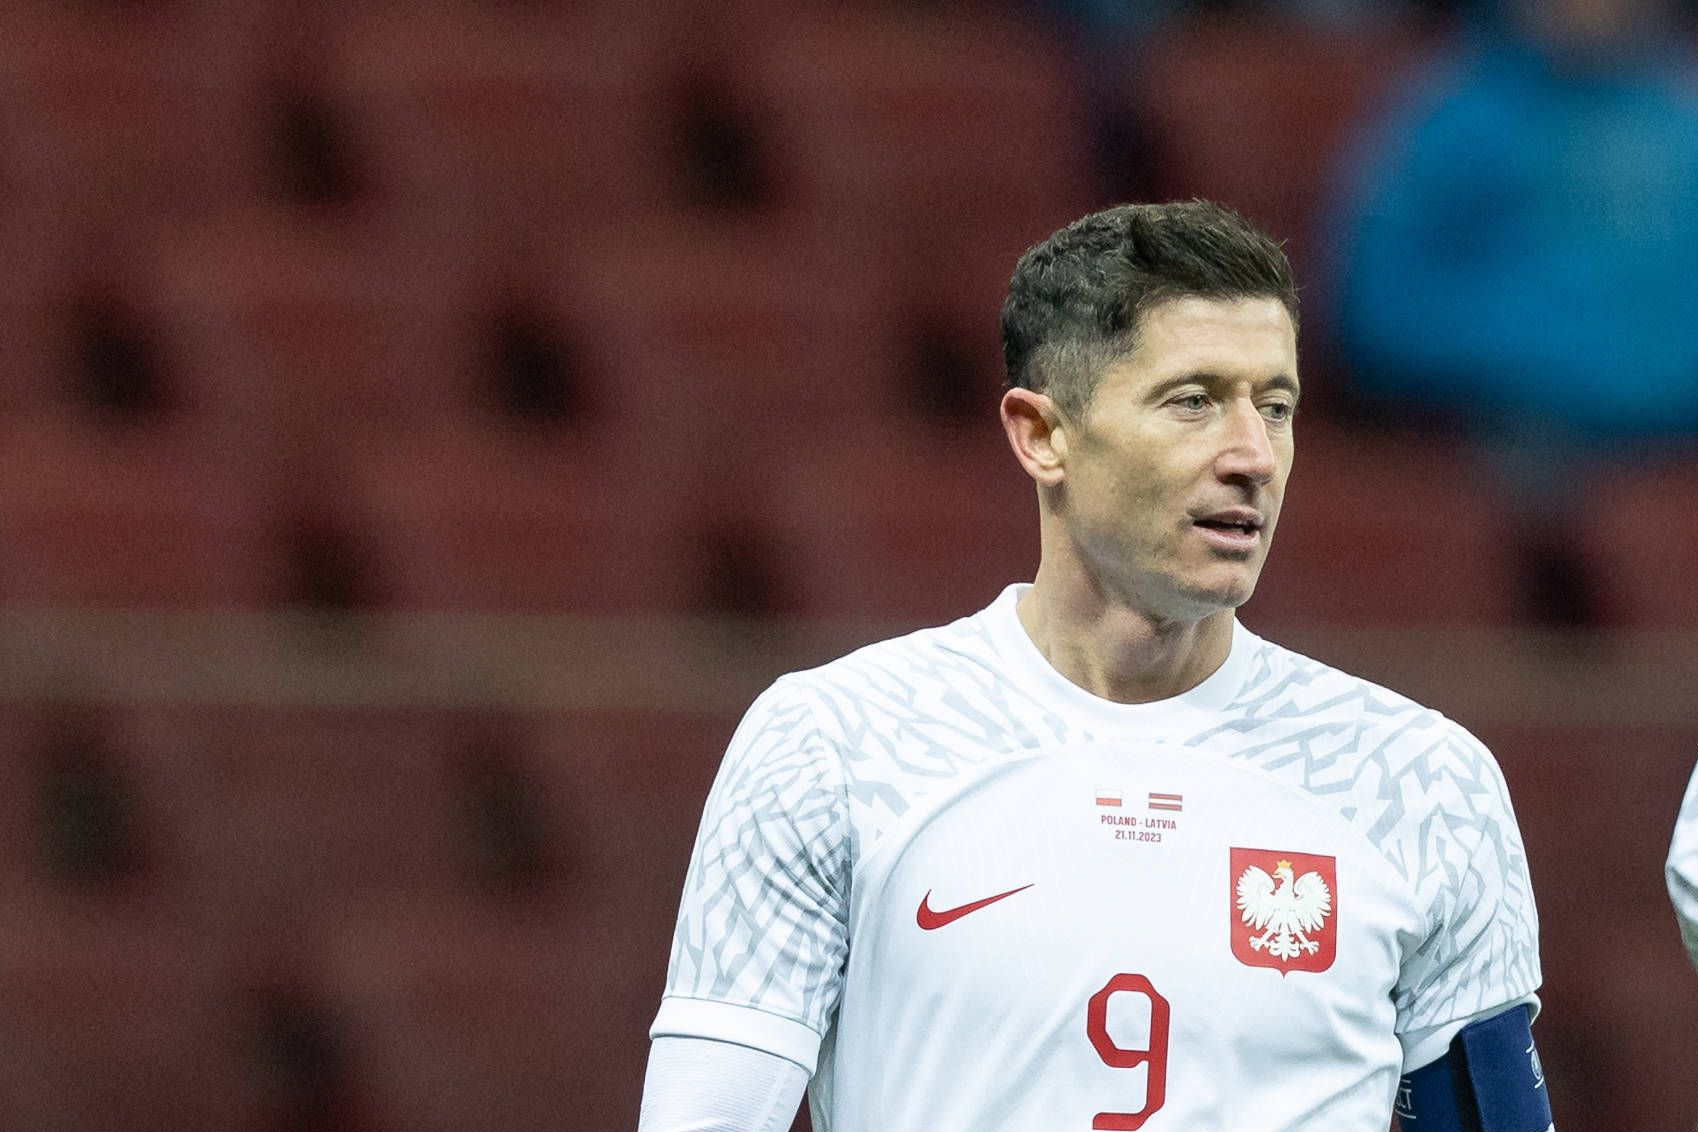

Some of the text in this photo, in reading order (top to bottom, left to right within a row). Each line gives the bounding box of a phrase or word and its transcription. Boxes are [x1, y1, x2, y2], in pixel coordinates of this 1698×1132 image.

[1101, 815, 1137, 827] POLAND
[1145, 818, 1177, 830] LATVIA
[1115, 830, 1162, 843] 21.11.2023
[1087, 973, 1170, 1132] 9
